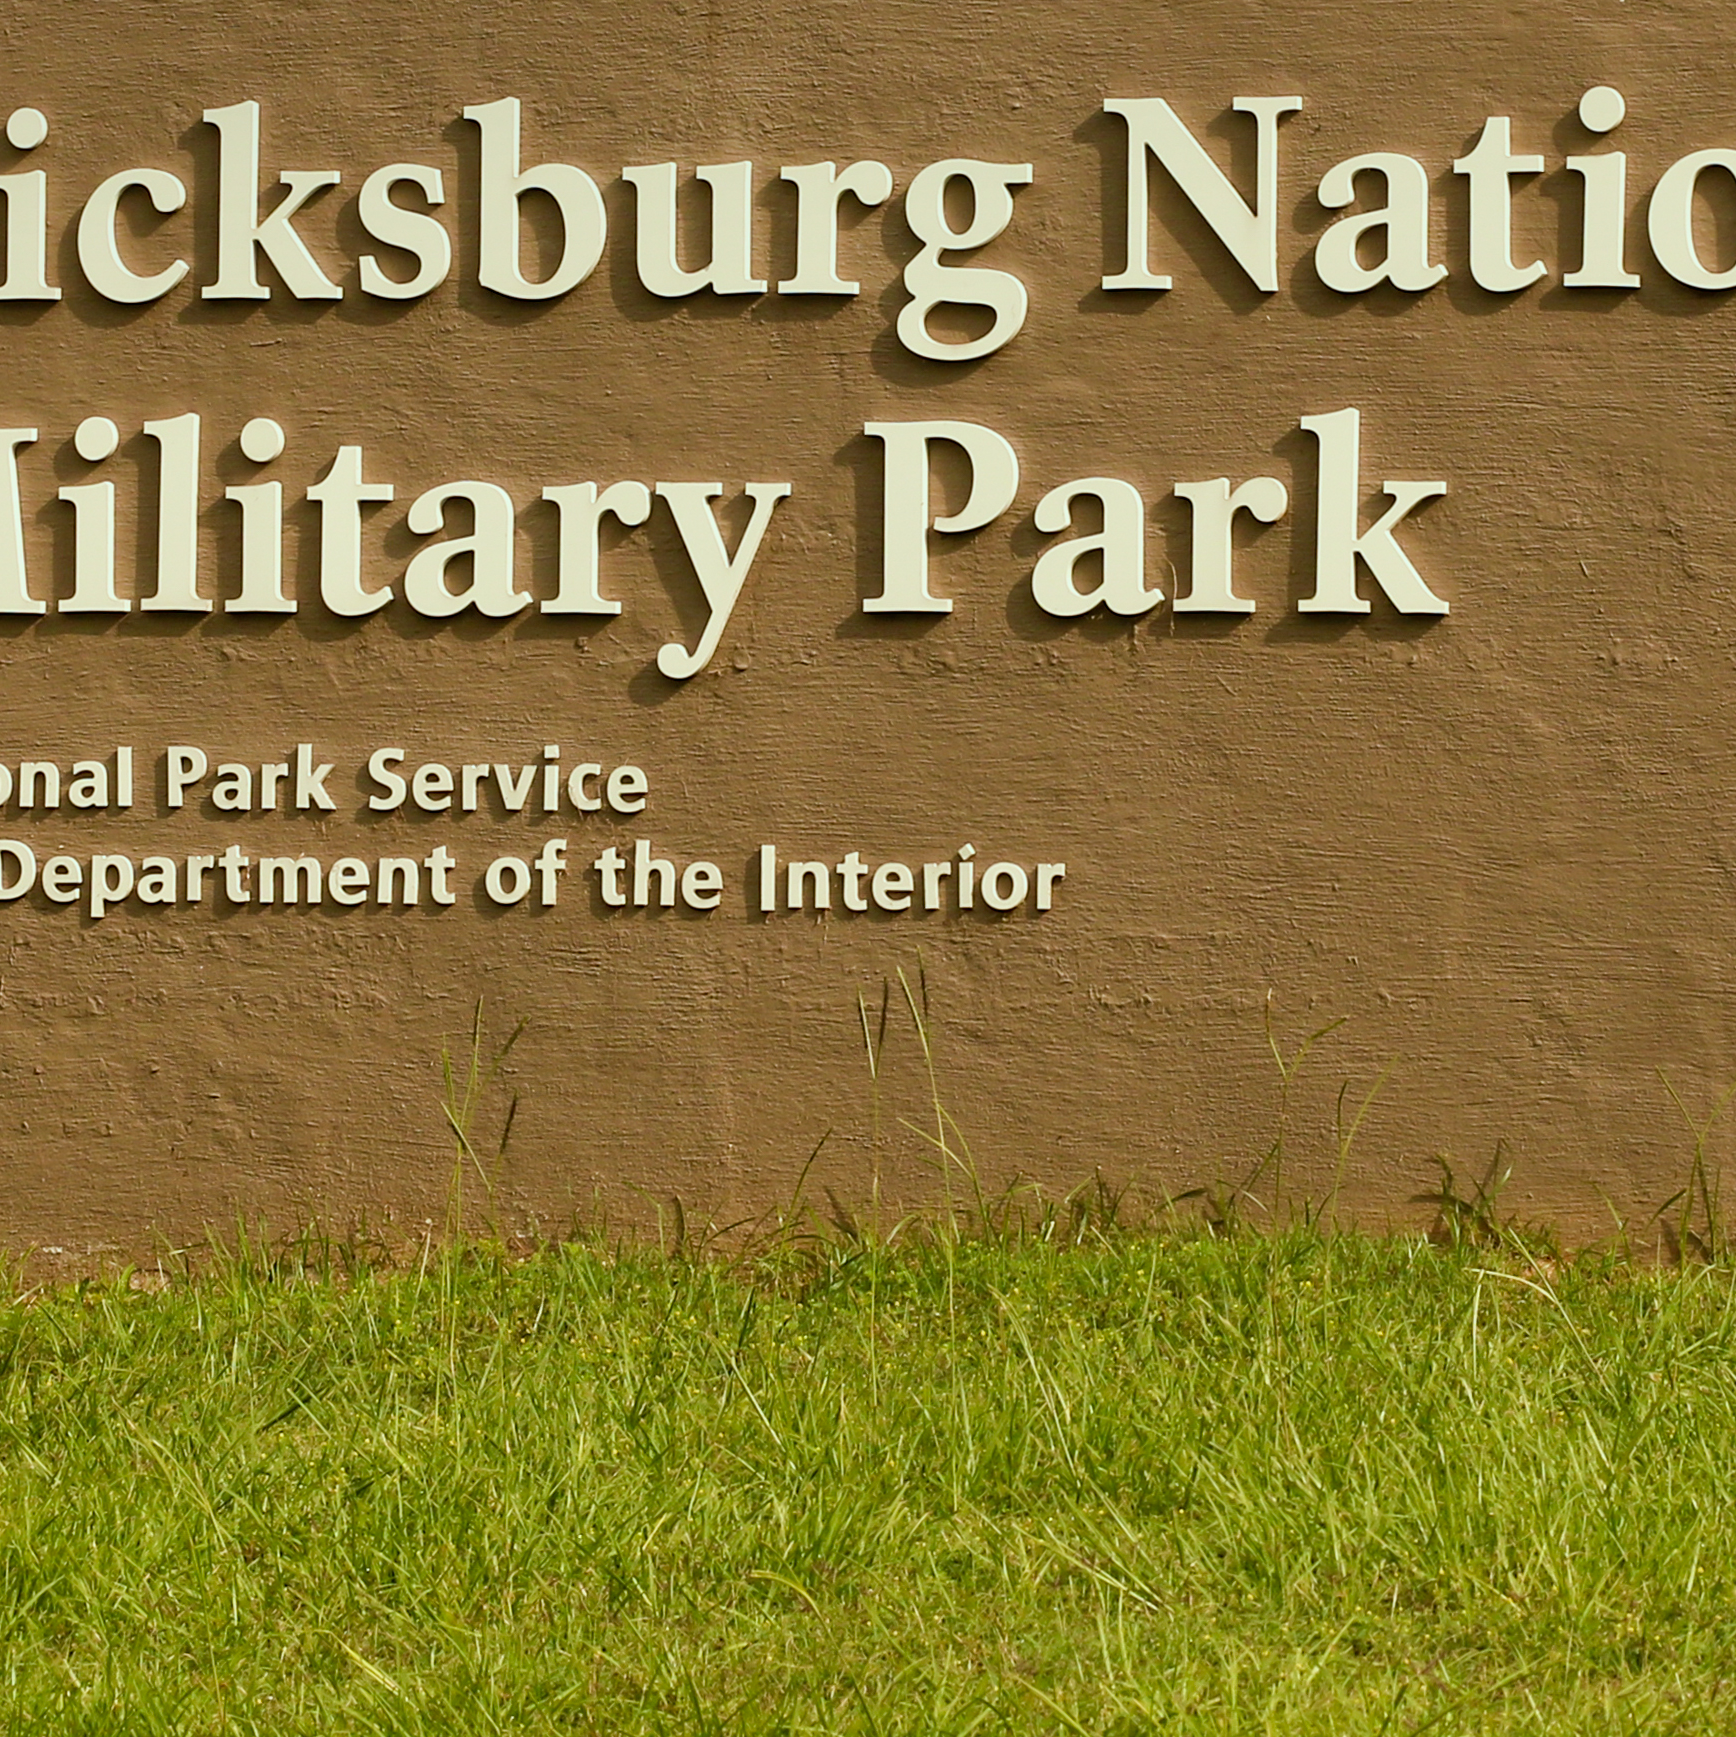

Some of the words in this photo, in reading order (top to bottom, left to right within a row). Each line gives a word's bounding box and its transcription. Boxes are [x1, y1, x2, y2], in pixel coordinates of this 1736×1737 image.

[863, 407, 1449, 616] Park
[168, 744, 336, 810] Park
[369, 745, 648, 812] Service
[486, 839, 567, 905] of
[595, 839, 723, 908] the
[761, 843, 1065, 910] Interior
